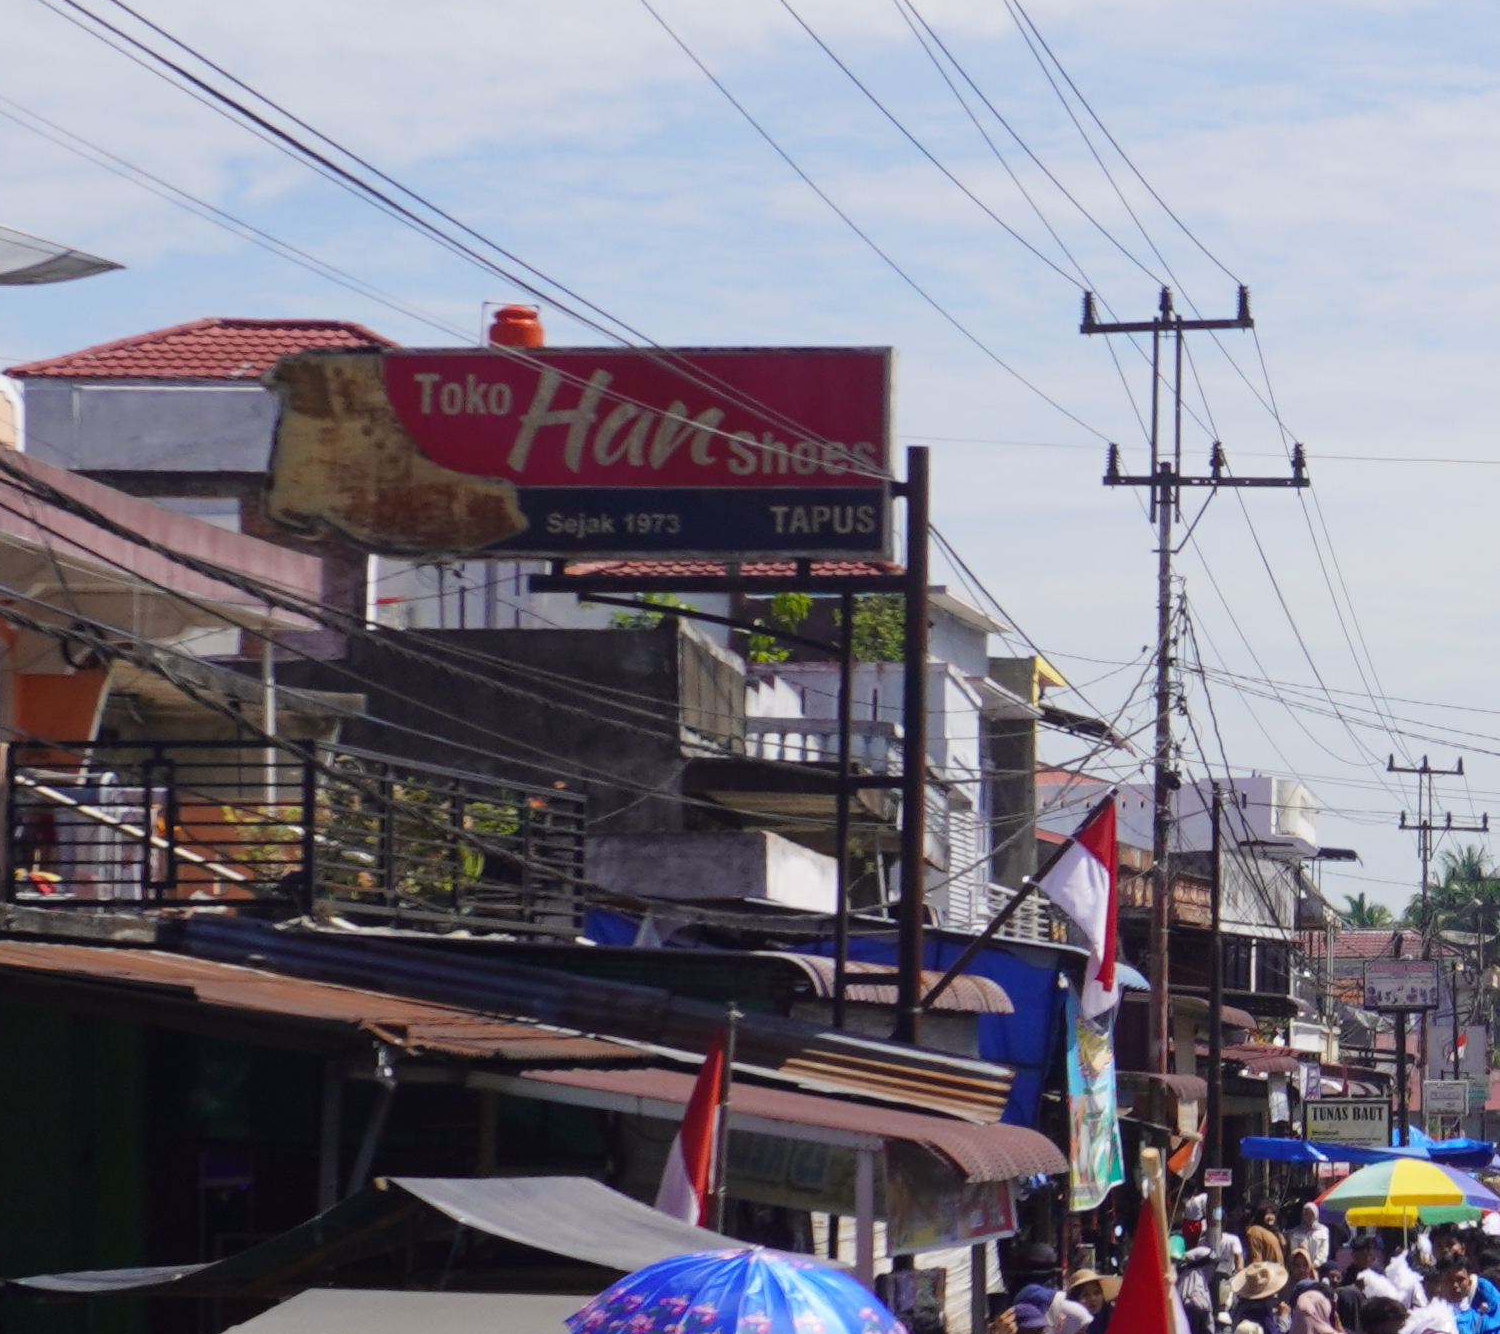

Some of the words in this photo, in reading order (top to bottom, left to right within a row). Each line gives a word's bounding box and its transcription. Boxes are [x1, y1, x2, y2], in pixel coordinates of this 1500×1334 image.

[414, 373, 512, 415] Toko
[507, 366, 725, 473] Han
[727, 430, 878, 476] Shoes
[547, 511, 615, 538] Sejak
[622, 512, 681, 535] 1973
[769, 504, 876, 535] TAPUS
[1312, 1106, 1348, 1122] TUNAS
[1352, 1106, 1384, 1122] BAUT
